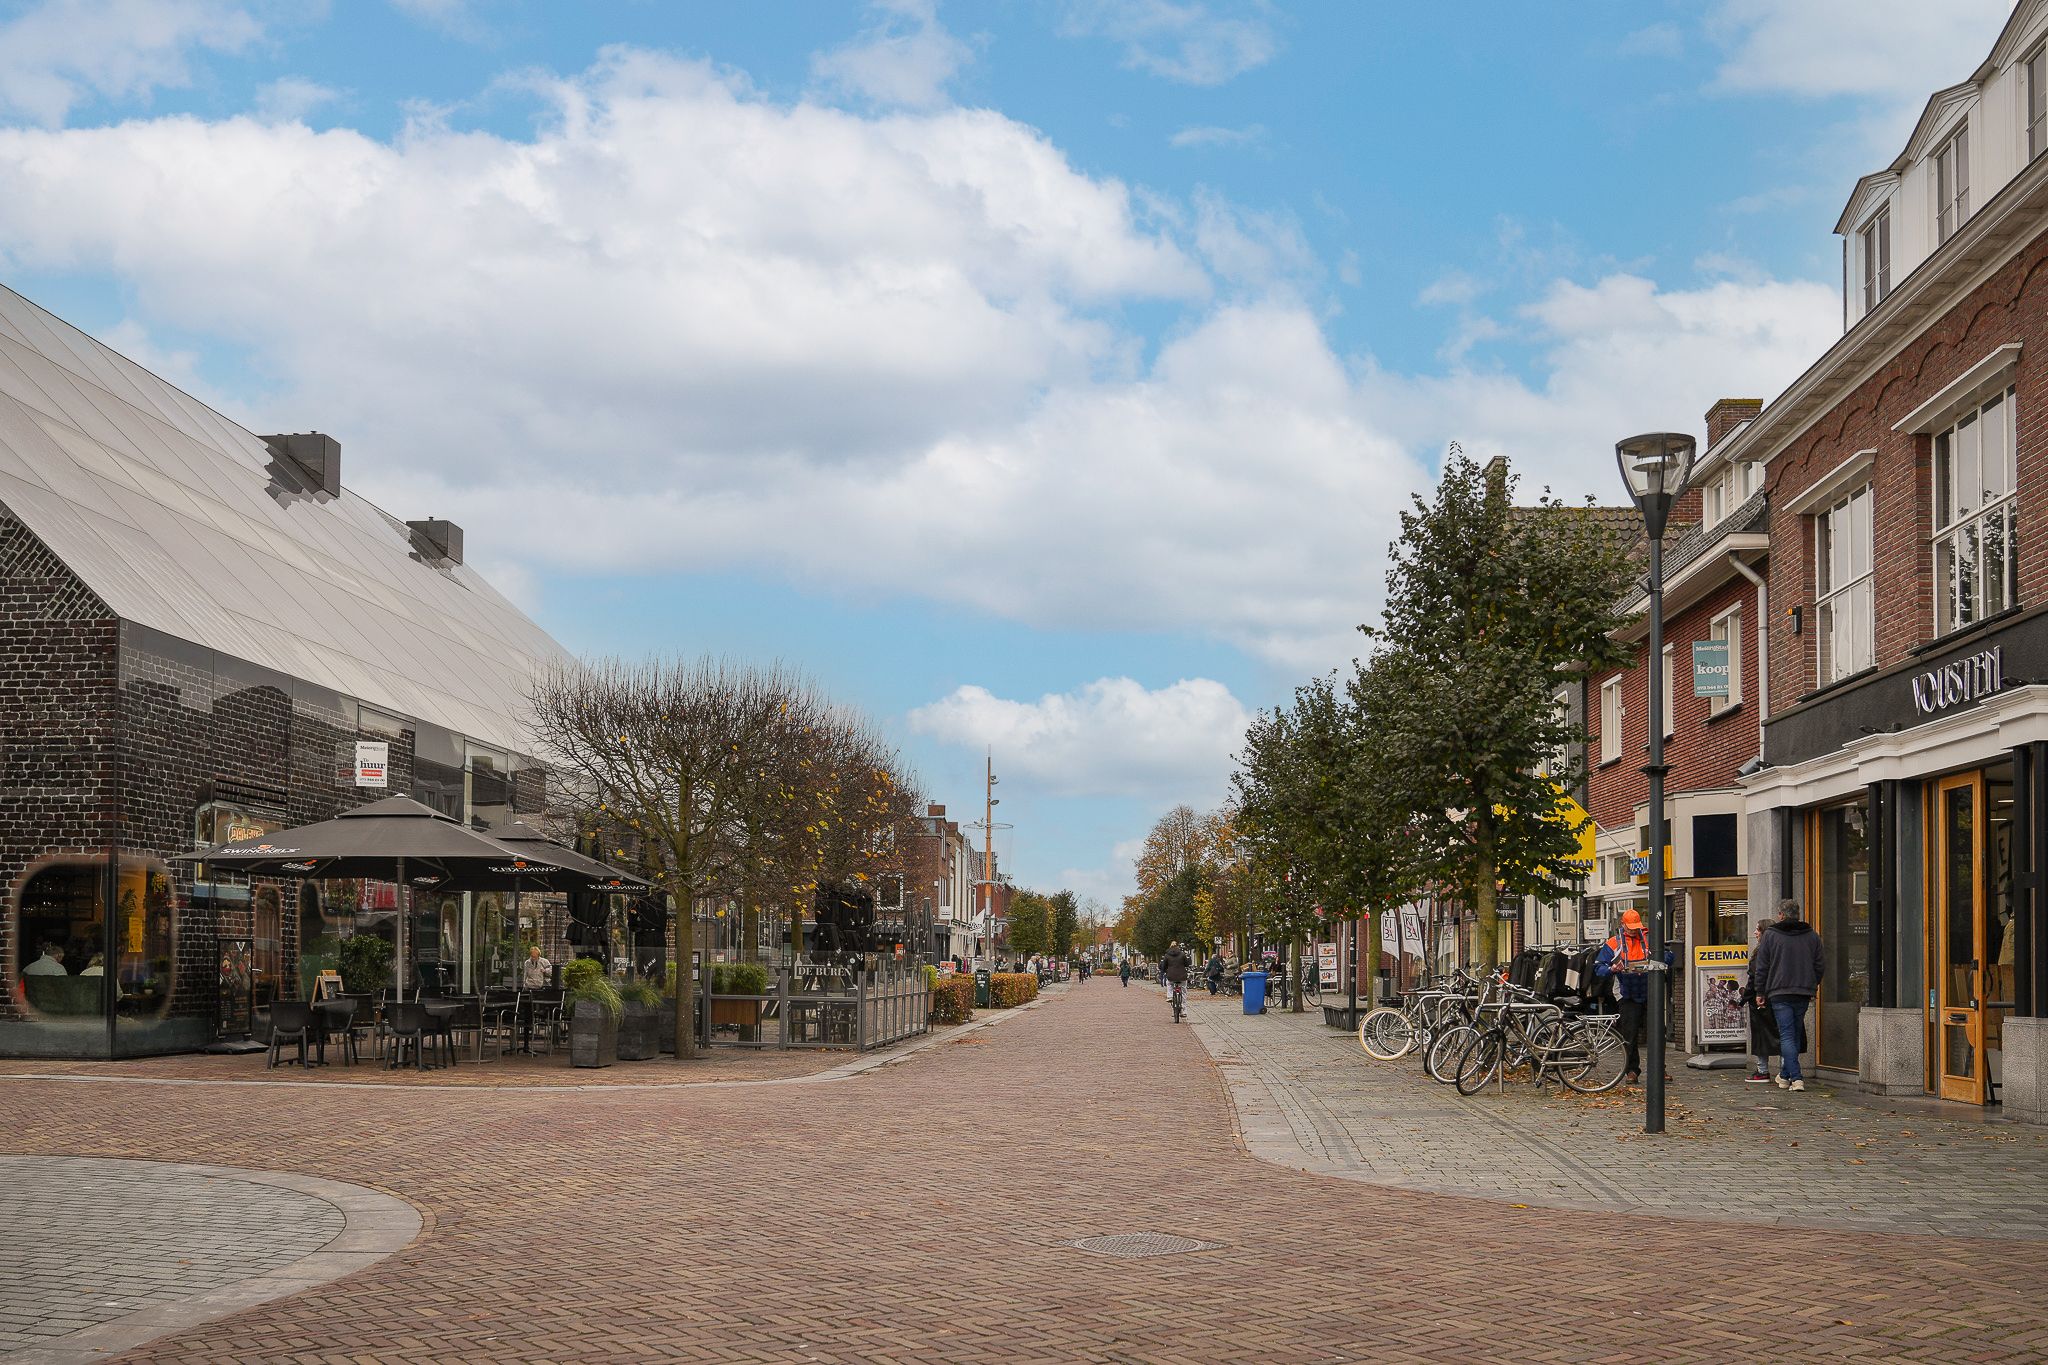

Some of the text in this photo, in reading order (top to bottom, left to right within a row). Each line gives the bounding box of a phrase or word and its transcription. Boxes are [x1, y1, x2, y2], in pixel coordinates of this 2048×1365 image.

[1912, 644, 2001, 717] VOUSTEN
[360, 761, 386, 769] huur
[1700, 951, 1748, 960] ZEEMAN
[798, 967, 852, 977] DE BUREN
